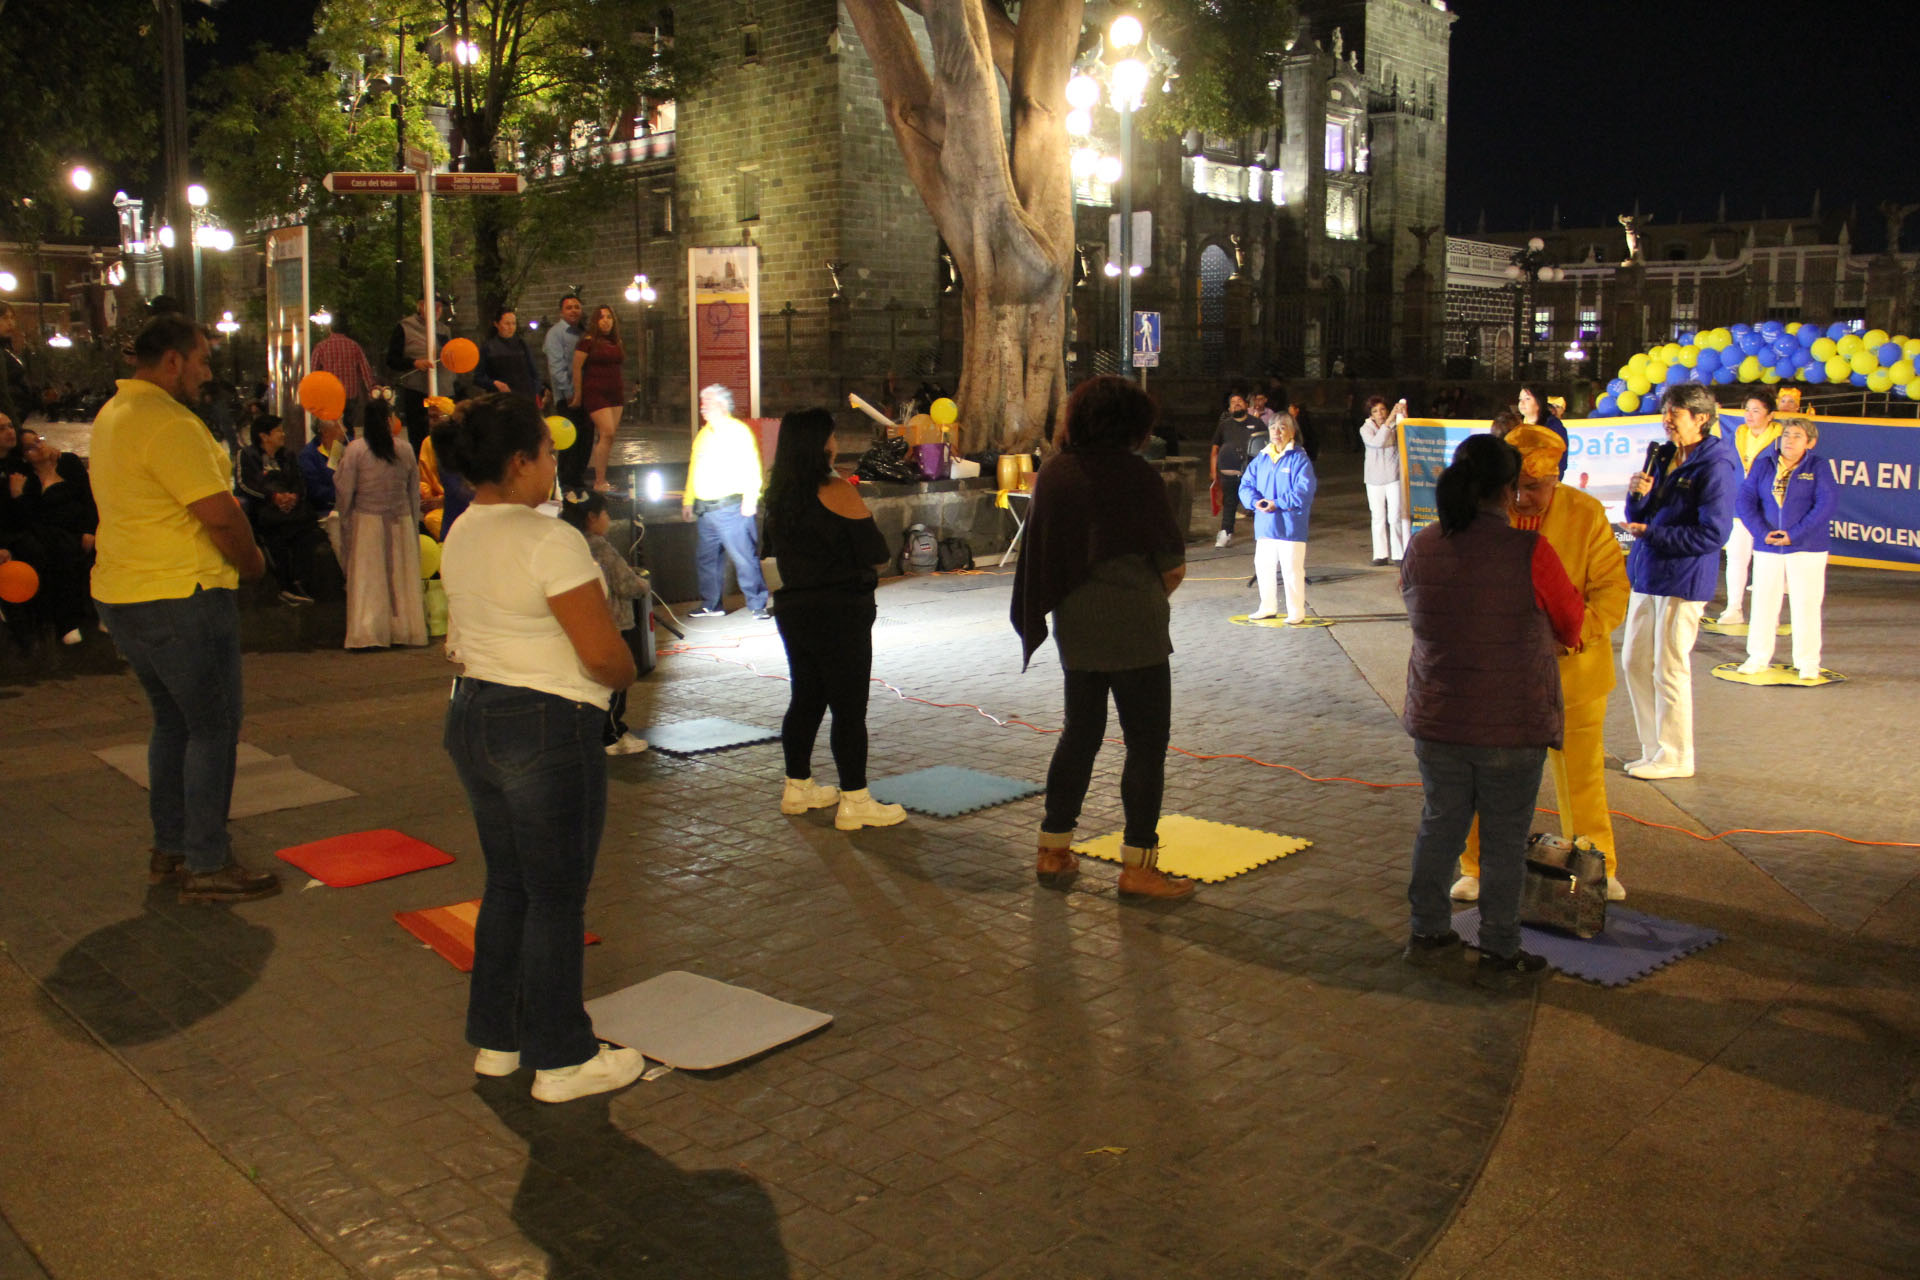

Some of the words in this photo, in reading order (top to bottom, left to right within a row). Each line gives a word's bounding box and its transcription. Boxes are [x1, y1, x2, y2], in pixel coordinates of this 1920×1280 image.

[351, 179, 367, 187] Casa
[368, 179, 379, 187] del
[1568, 431, 1631, 456] Dafa
[1876, 462, 1912, 490] EN
